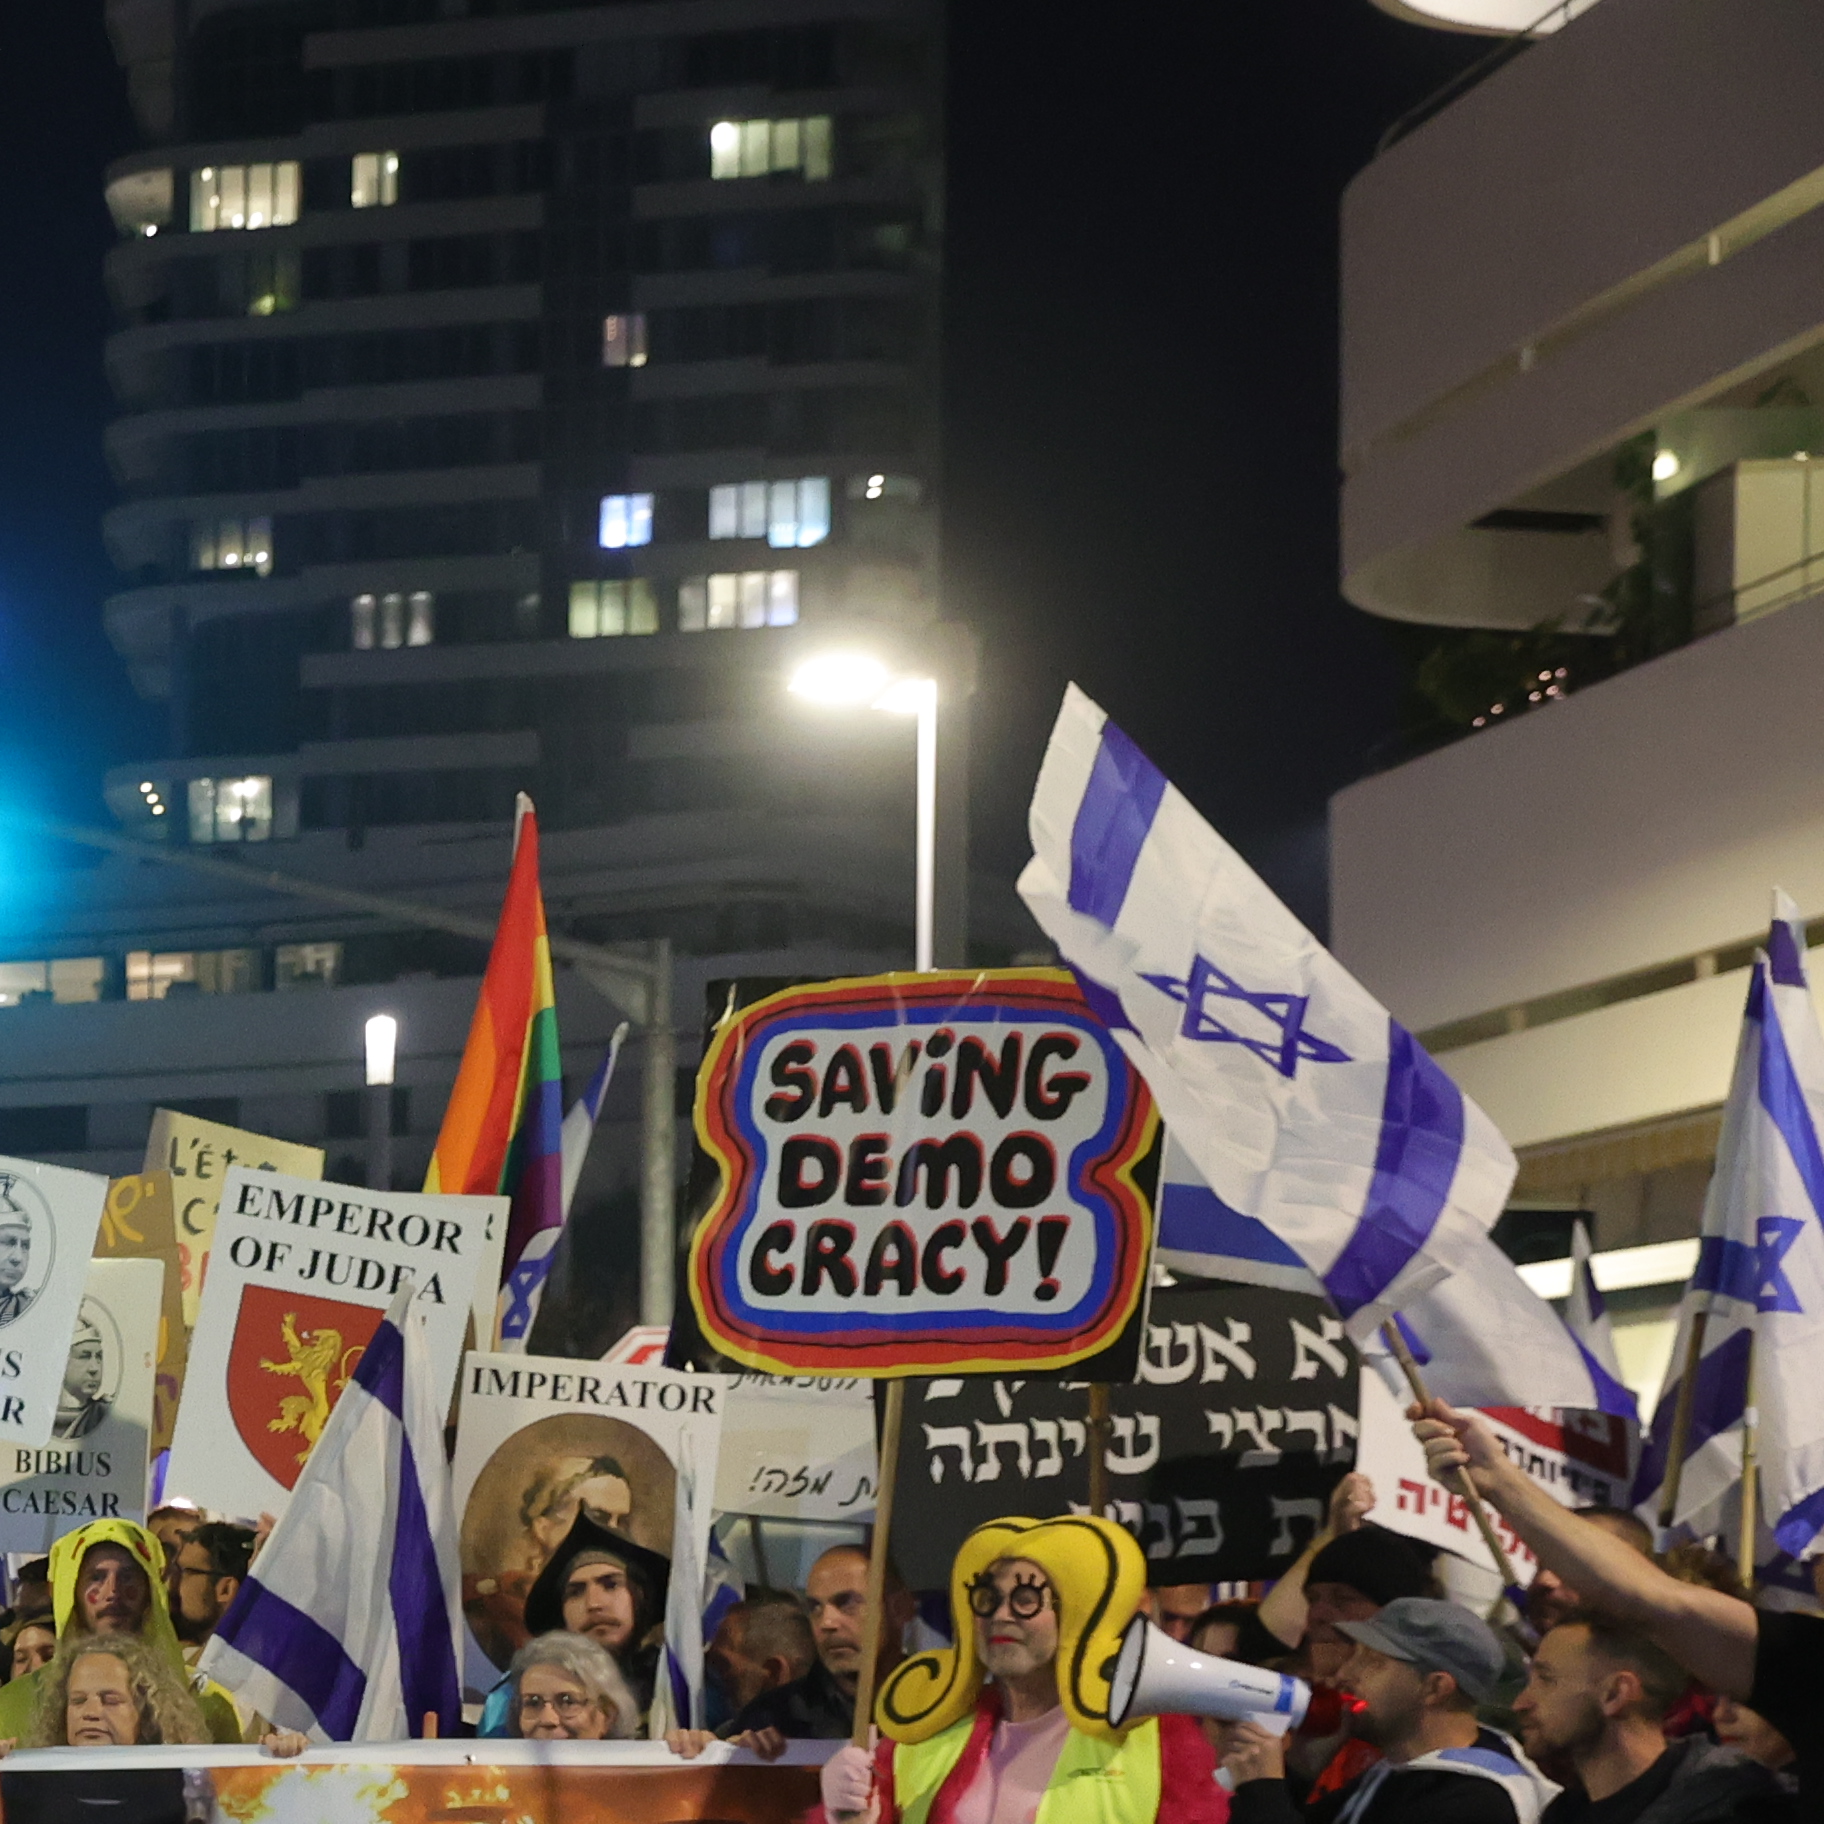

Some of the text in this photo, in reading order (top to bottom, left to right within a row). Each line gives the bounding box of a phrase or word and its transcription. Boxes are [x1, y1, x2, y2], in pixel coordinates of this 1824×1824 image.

[776, 1129, 1058, 1211] DEMO
[233, 1182, 463, 1256] EMPEROR
[230, 1235, 293, 1272] OF
[298, 1248, 447, 1305] JUDEA
[749, 1213, 1072, 1303] CRACY!
[1288, 1314, 1350, 1383] א
[469, 1365, 719, 1415] IMPERATOR
[14, 1449, 112, 1477] BIBIUS
[921, 1410, 1162, 1484] שינתה
[2, 1488, 120, 1518] CAESAR
